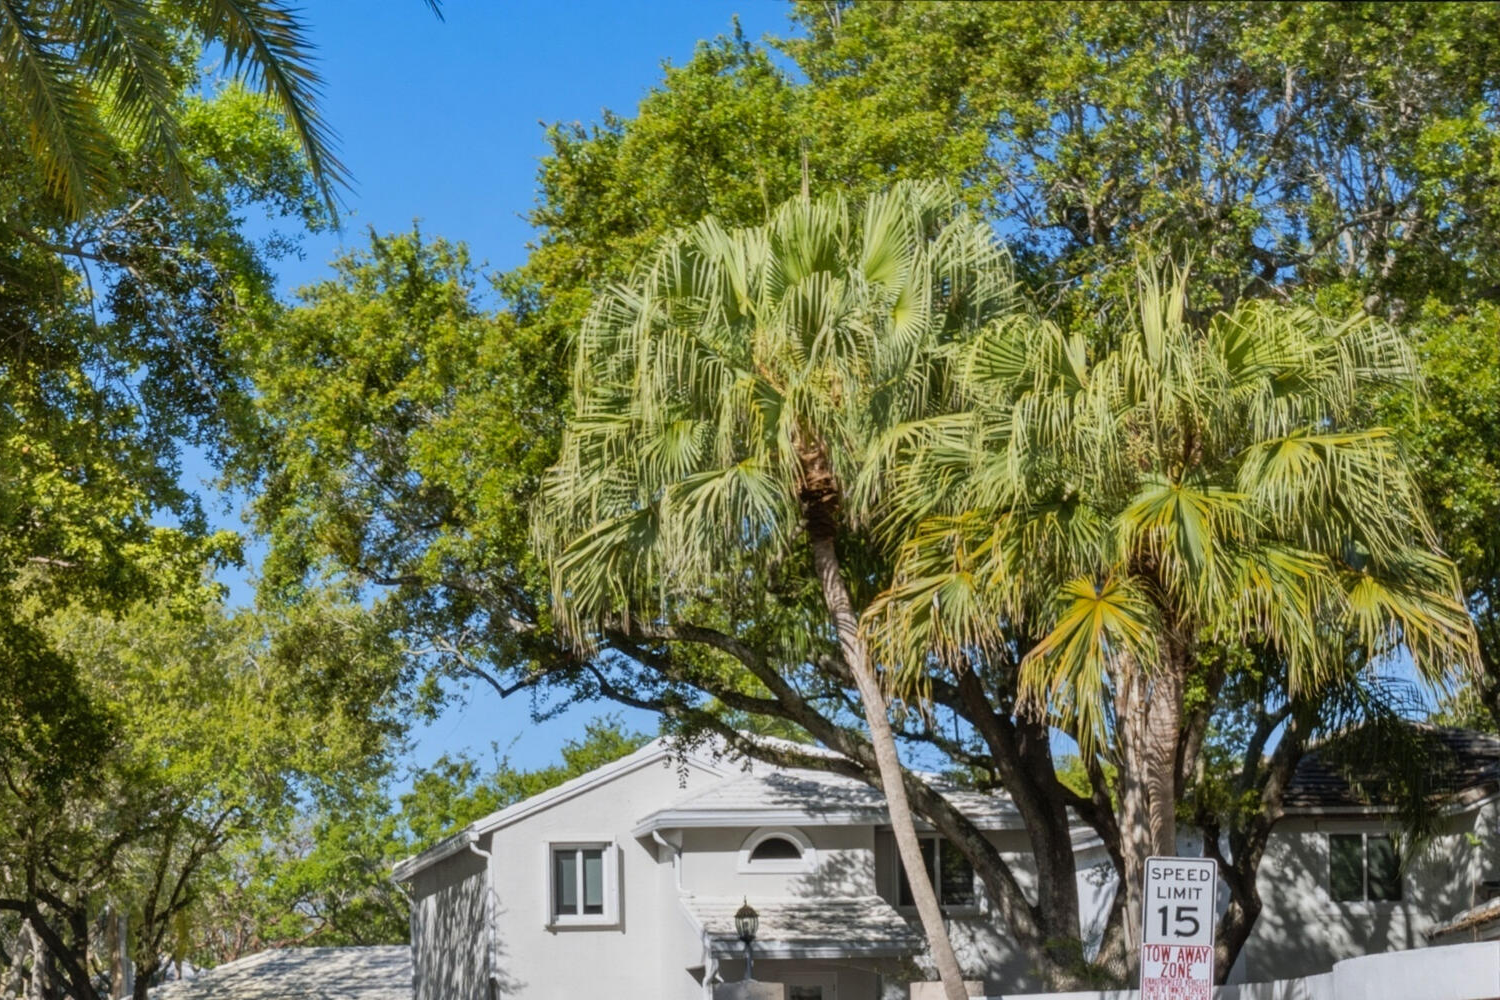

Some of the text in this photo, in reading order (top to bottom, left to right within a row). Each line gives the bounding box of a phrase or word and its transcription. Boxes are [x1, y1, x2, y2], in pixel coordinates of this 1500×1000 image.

[1151, 867, 1210, 881] SPEED
[1156, 886, 1203, 900] LIMIT
[1157, 905, 1200, 937] 15
[1146, 945, 1210, 964] TOW AWAY
[1160, 963, 1193, 979] ZONE
